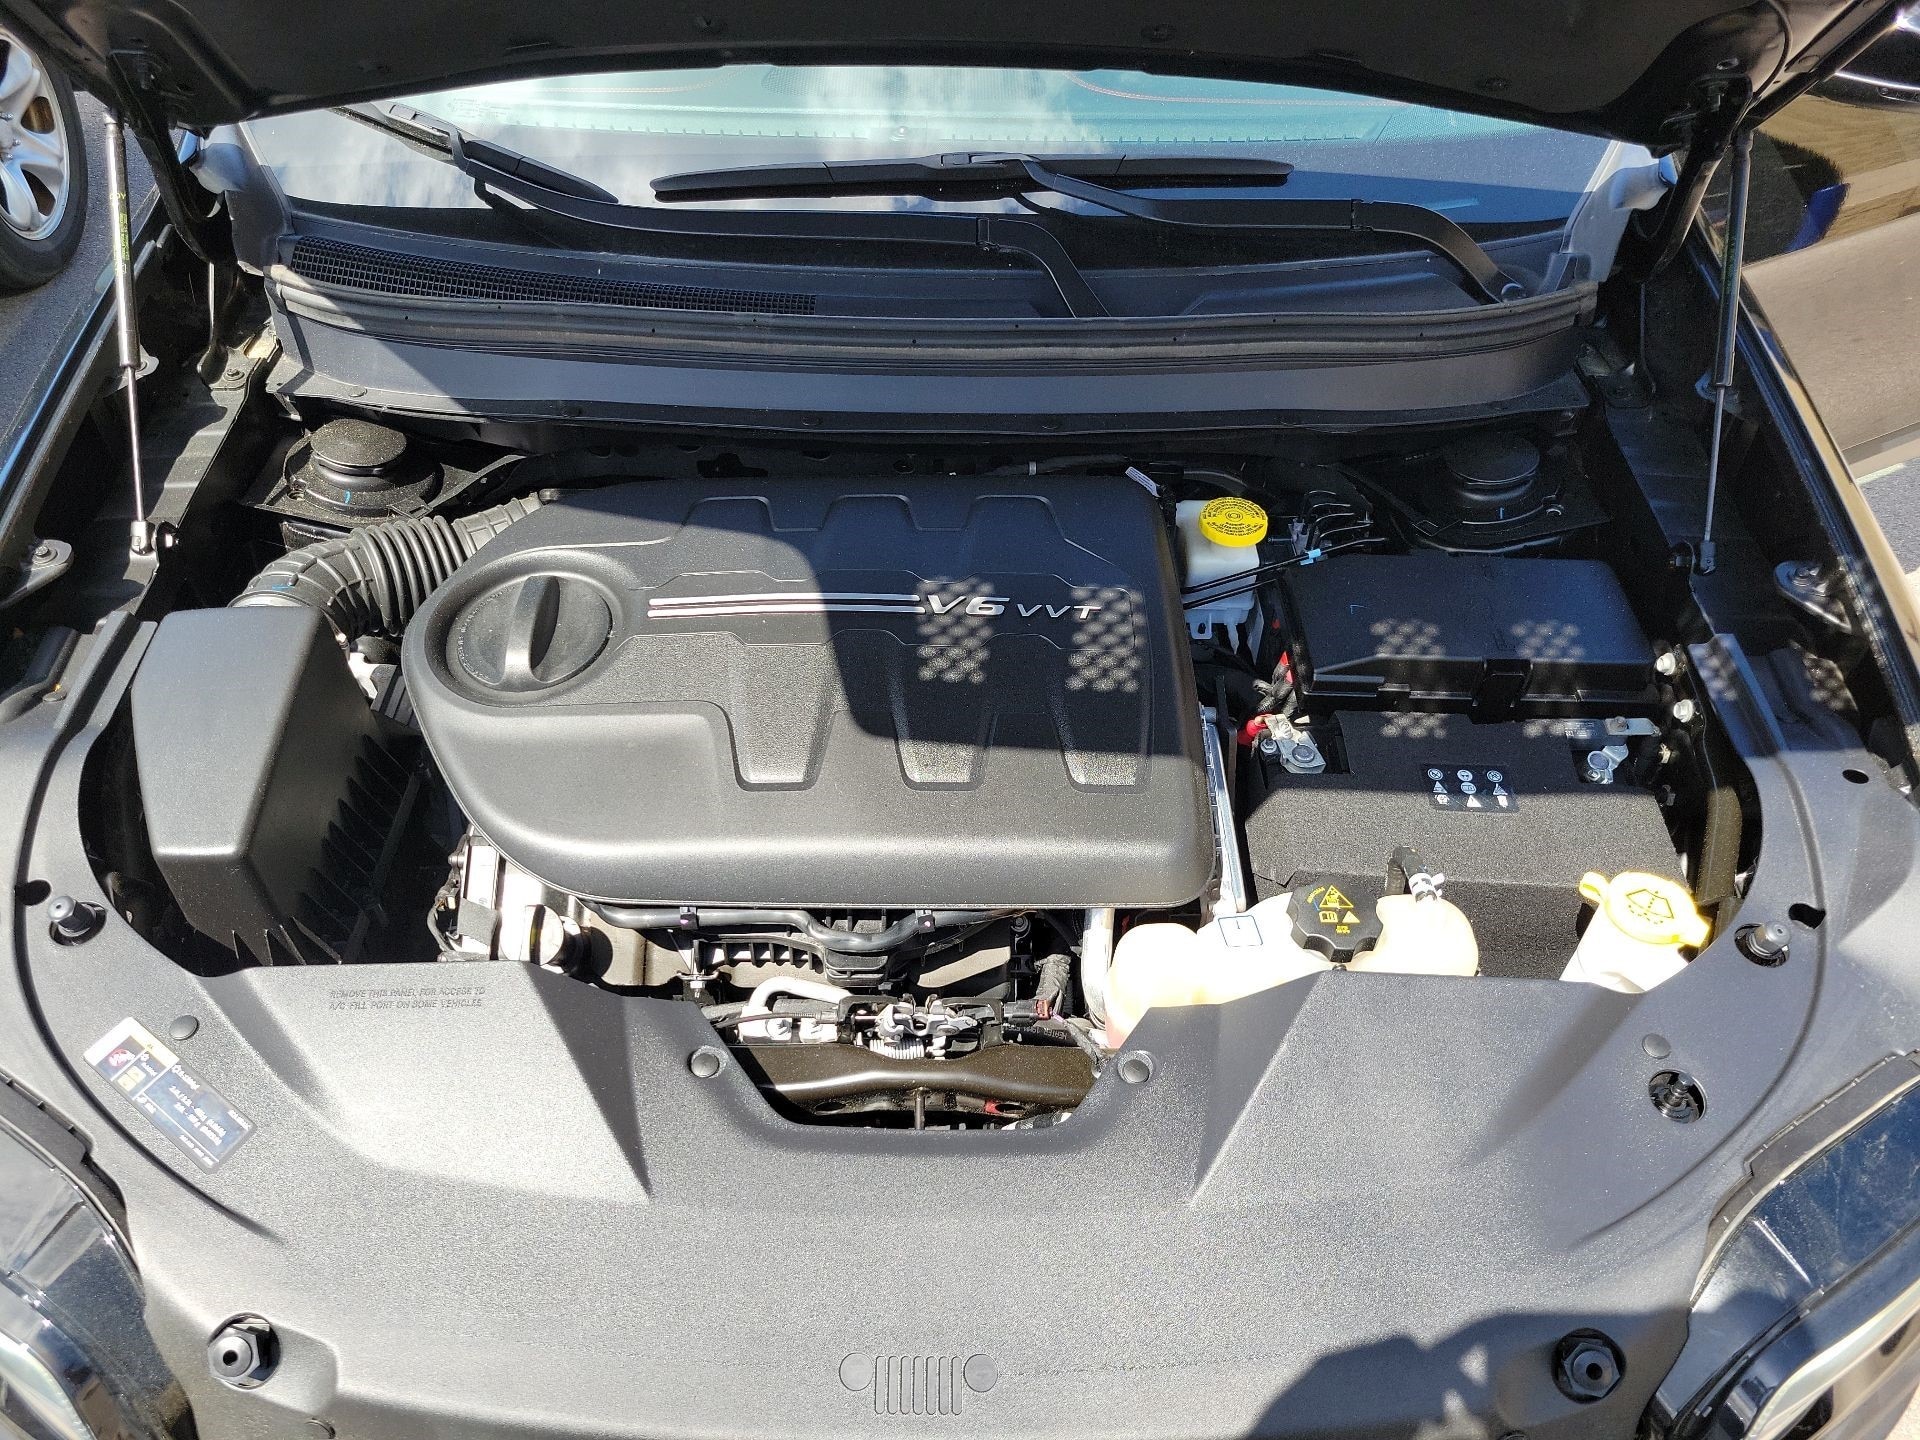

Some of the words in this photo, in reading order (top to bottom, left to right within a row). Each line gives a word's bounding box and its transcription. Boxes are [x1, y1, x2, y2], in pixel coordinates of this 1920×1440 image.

[927, 594, 1011, 616] V6
[1017, 603, 1102, 619] VVT
[330, 989, 366, 999] REMOVE
[420, 987, 437, 996] FOR
